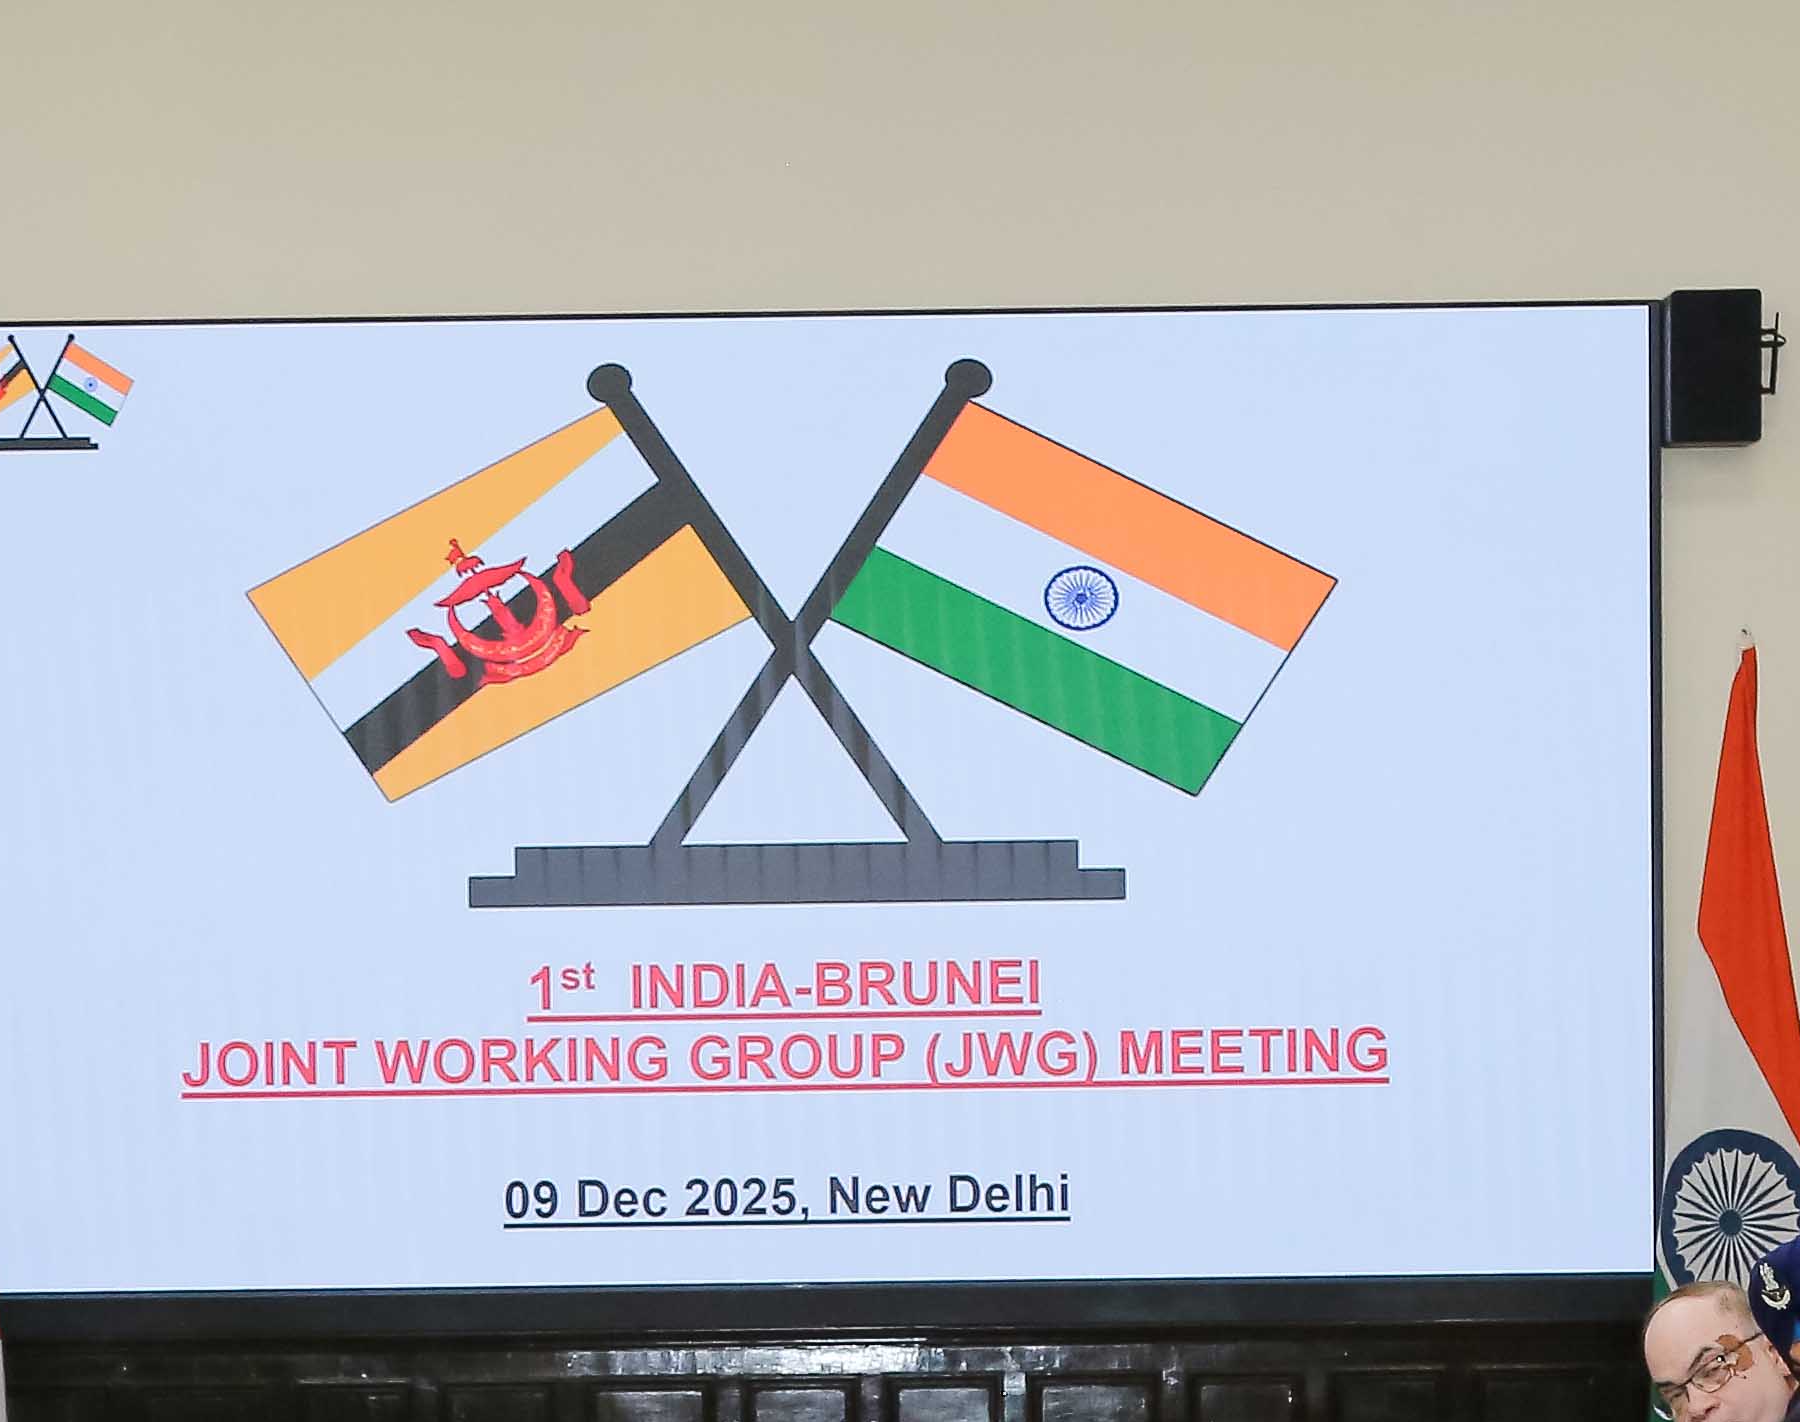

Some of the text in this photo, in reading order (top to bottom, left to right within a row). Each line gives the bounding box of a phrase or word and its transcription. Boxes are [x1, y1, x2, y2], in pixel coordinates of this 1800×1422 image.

[529, 959, 1041, 1011] 1st INDIA-BRUNEI
[181, 1025, 1390, 1087] JOINT WORKING GROUP (JWG) MEETING
[504, 1172, 1071, 1221] 09 Dec 2025, New Delhi
